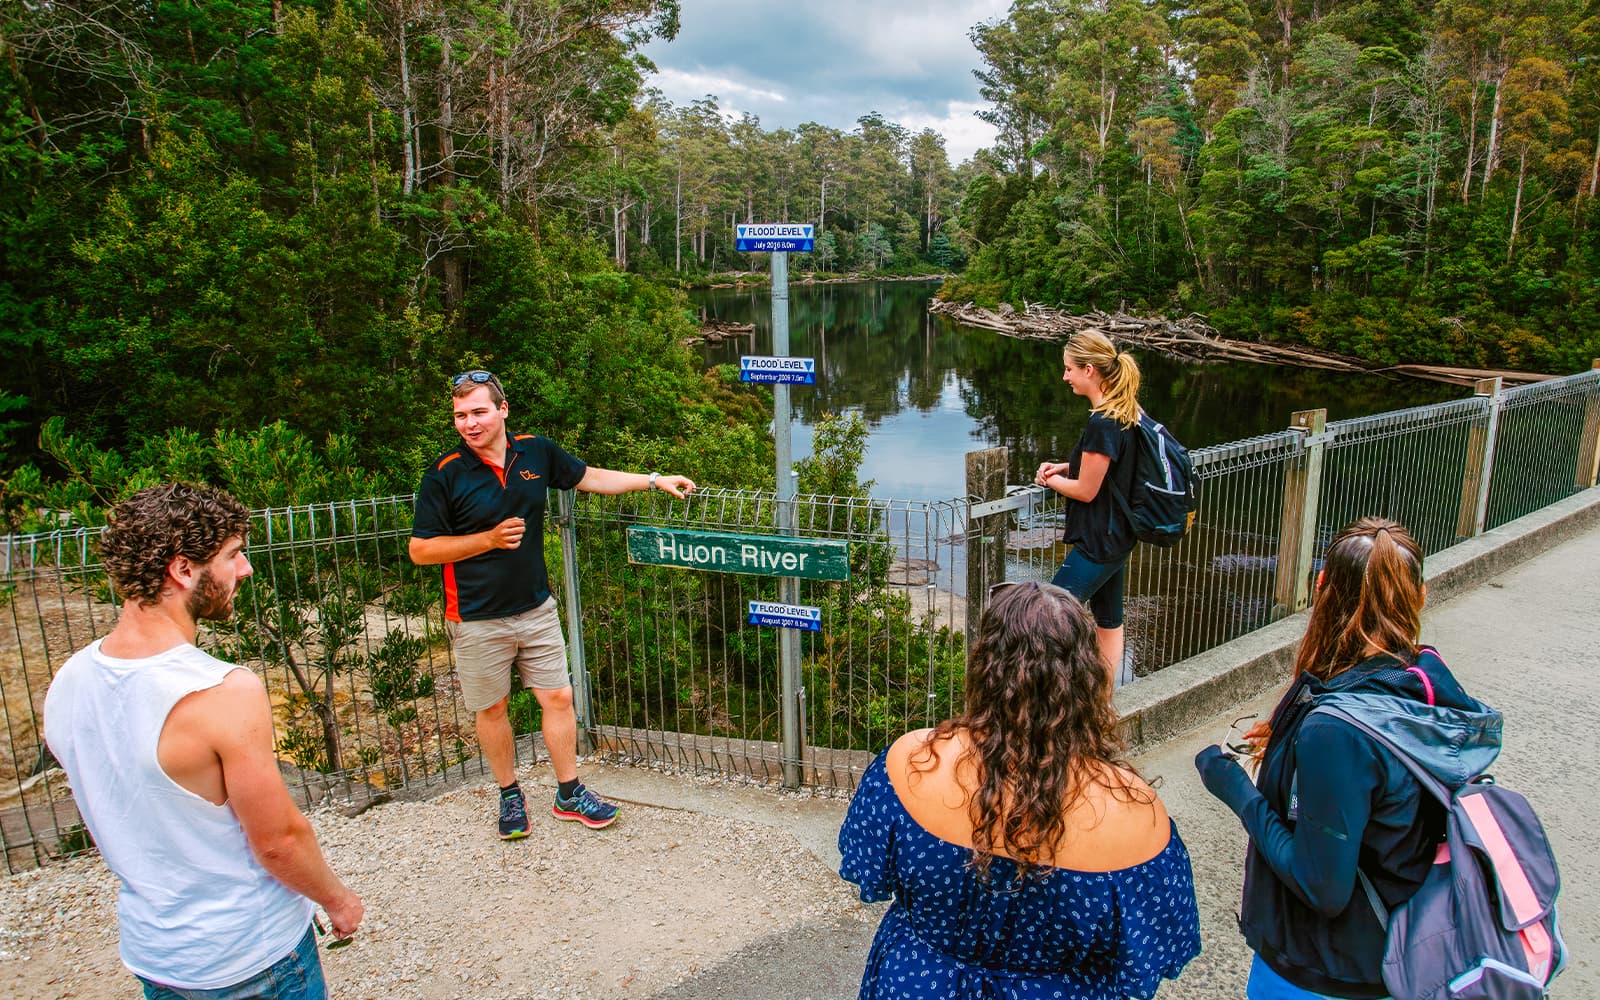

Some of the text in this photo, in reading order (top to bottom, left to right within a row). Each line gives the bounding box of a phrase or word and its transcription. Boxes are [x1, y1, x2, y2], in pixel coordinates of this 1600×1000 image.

[748, 227, 802, 236] FLOOD LEVEL
[754, 241, 766, 250] July
[751, 359, 804, 369] FLOOD LEVEL
[750, 372, 778, 381] September
[658, 535, 809, 571] Huon River
[759, 604, 810, 617] FLOOD LEVEL
[761, 616, 781, 625] August
